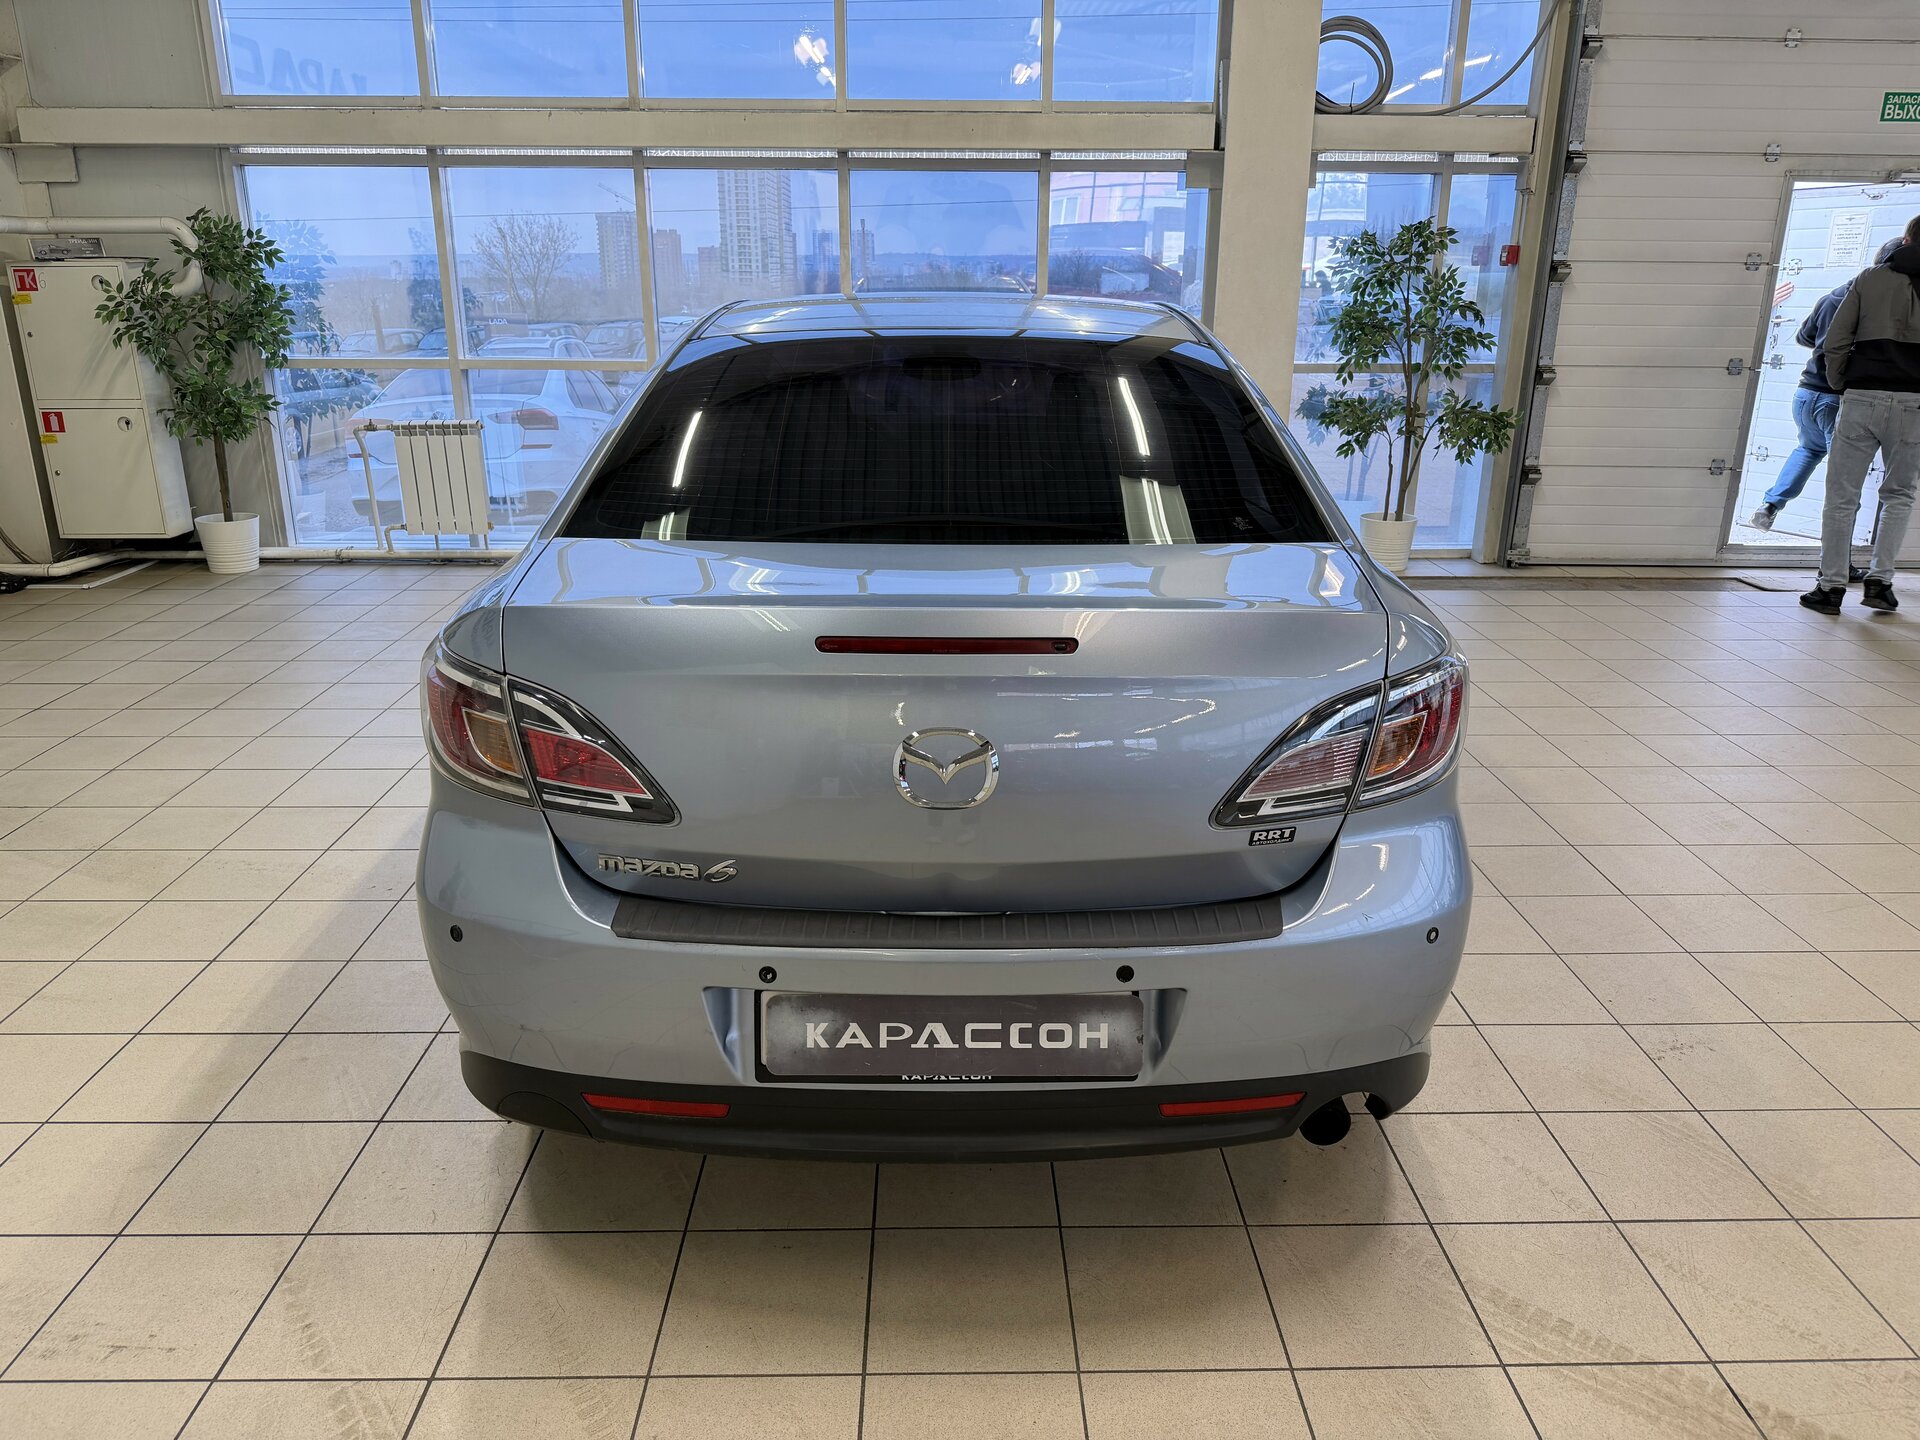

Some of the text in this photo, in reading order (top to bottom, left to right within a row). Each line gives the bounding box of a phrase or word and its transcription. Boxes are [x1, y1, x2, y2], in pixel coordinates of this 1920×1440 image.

[14, 271, 38, 289] ПК
[1253, 828, 1295, 841] RRT
[704, 859, 738, 883] 6
[805, 1022, 1109, 1049] КАРАССОН
